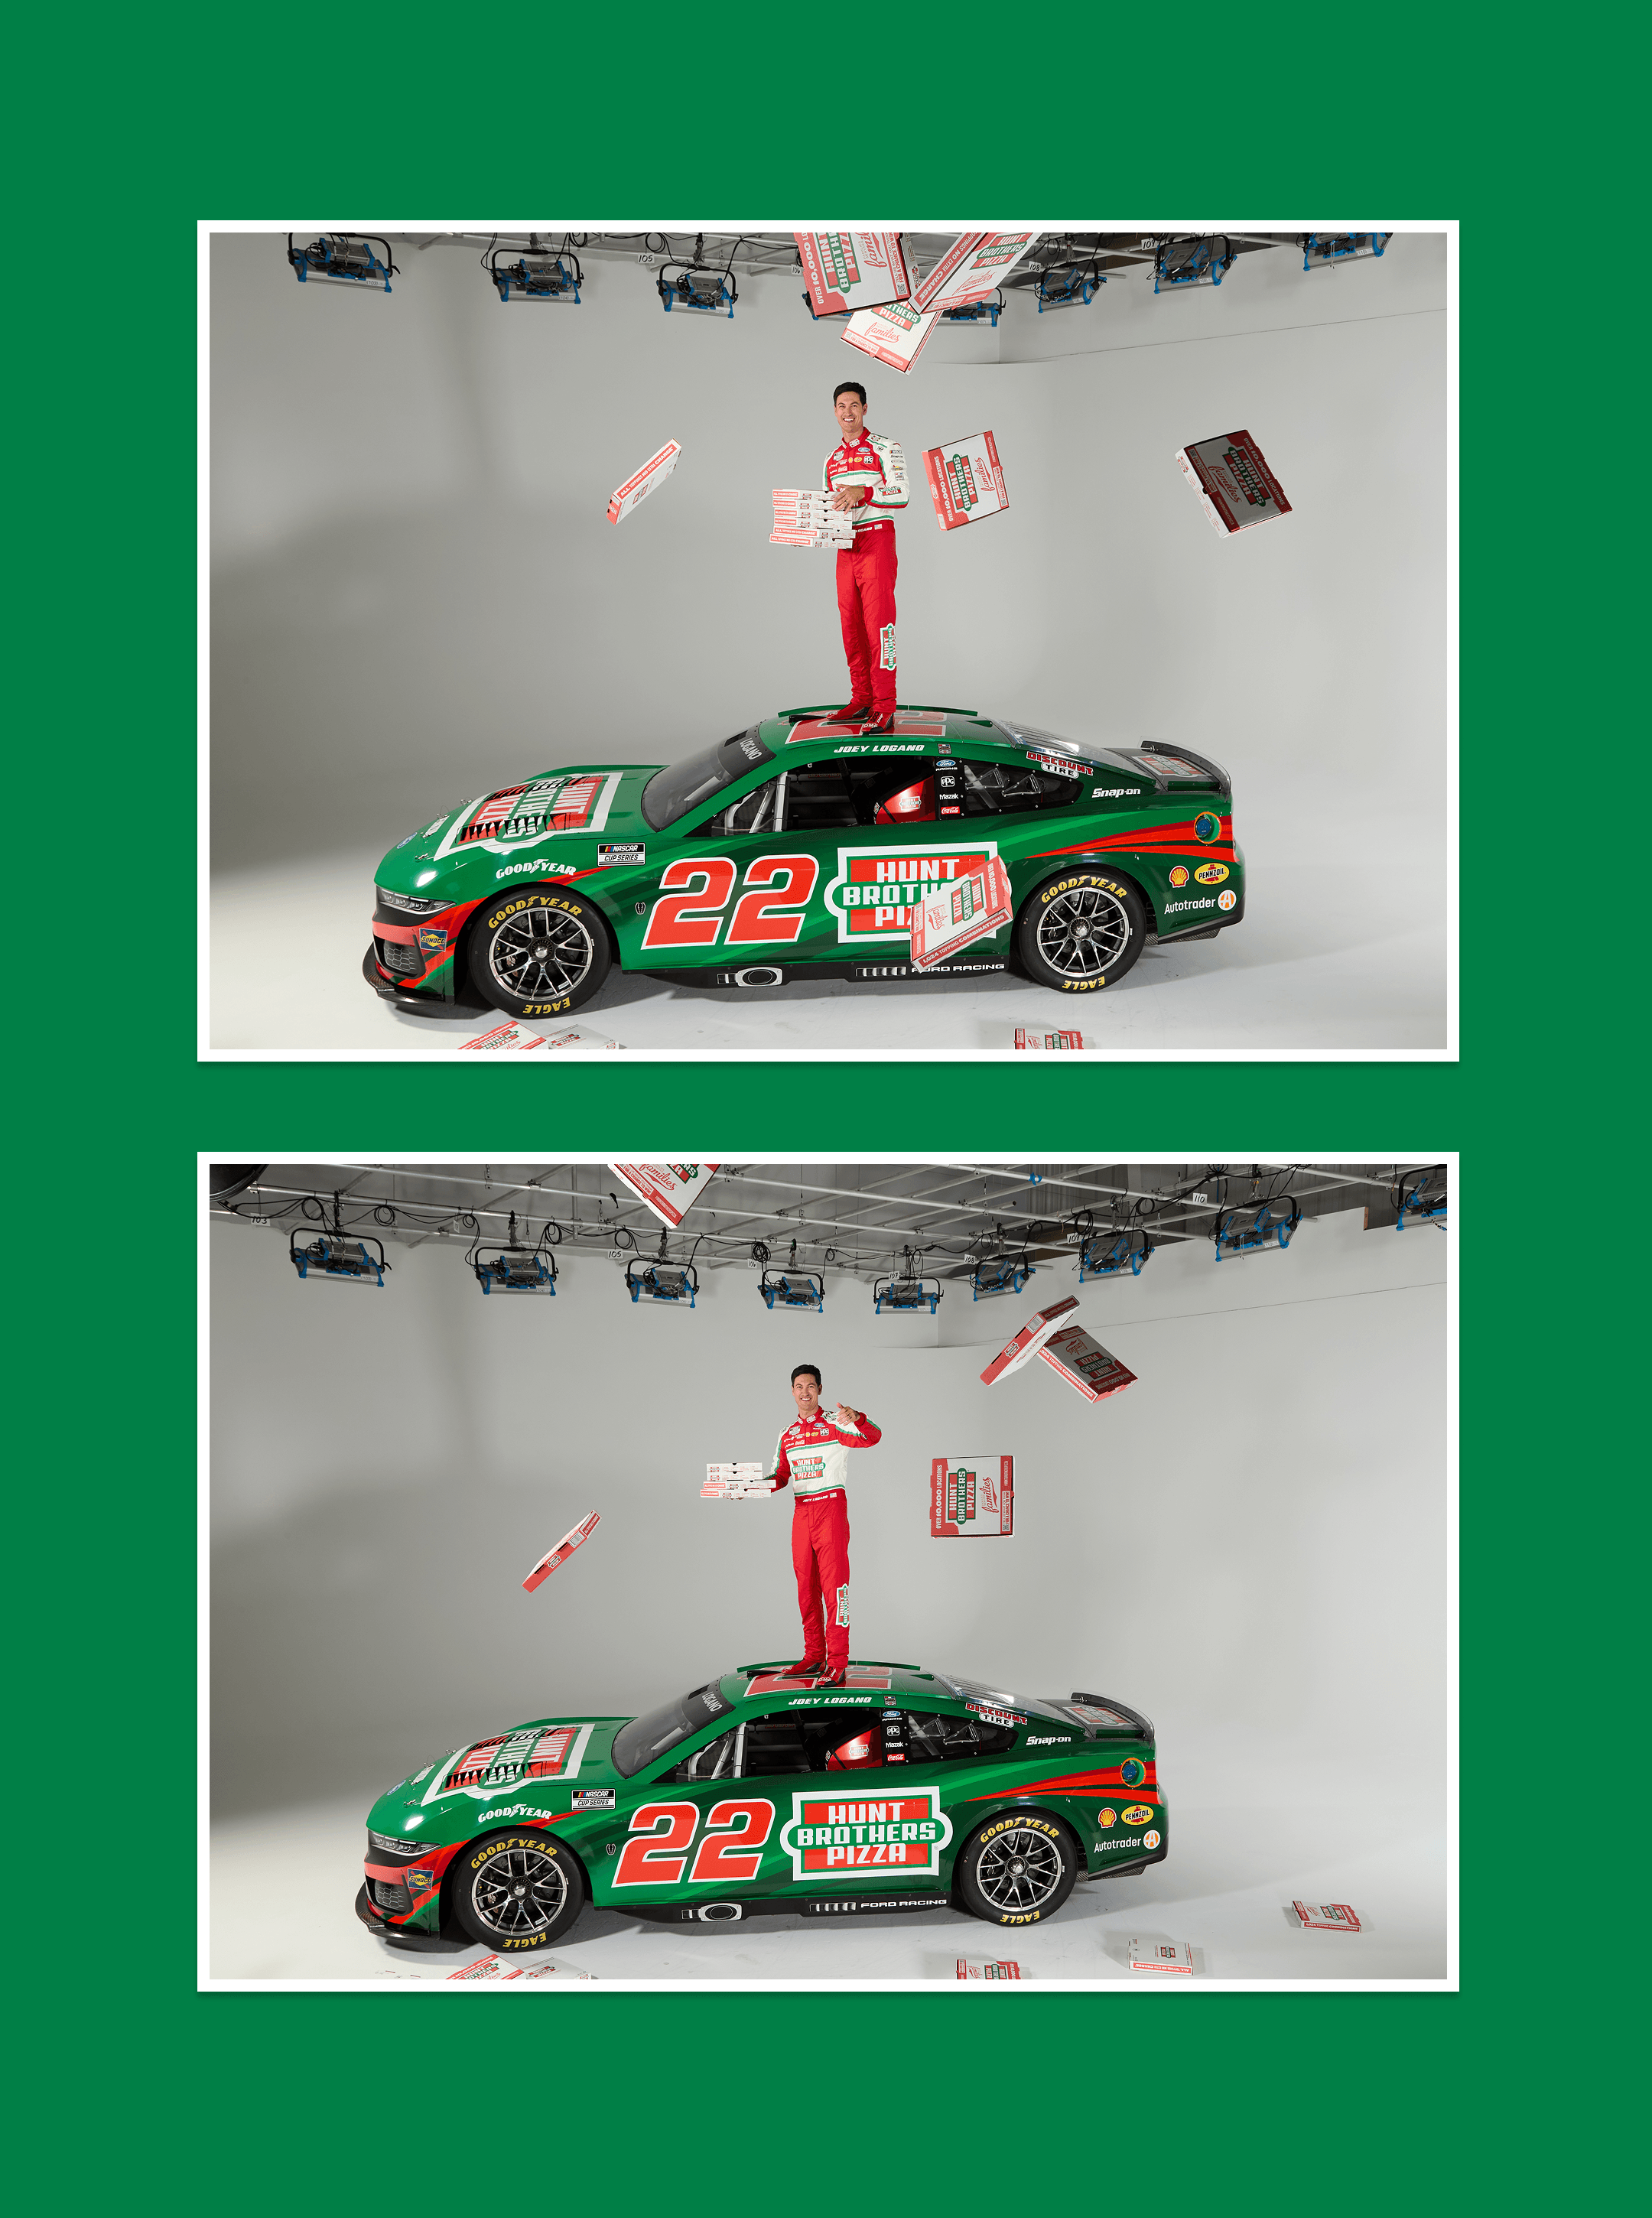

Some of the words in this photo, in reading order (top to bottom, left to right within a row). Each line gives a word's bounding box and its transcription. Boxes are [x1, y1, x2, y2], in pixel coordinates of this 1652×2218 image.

[960, 233, 977, 252] OPPINGS
[979, 242, 1025, 258] BROTHERS
[997, 233, 1026, 246] HUNT
[1143, 239, 1156, 249] 109
[639, 255, 653, 263] 105
[804, 242, 820, 285] 10,000
[830, 233, 850, 288] BROTH
[942, 260, 954, 272] EXTRA
[952, 250, 961, 260] NO
[980, 255, 1009, 267] PIZZA
[1029, 263, 1040, 272] 108
[815, 287, 824, 304] OVER
[920, 271, 944, 301] CHARGE
[879, 307, 906, 327] PIZZA
[886, 303, 919, 323] OTHERS
[864, 321, 901, 343] families
[620, 484, 631, 496] ALL
[654, 447, 673, 465] CHARGE
[934, 456, 944, 481] LOCATIONS
[964, 464, 975, 495] PIZZA
[974, 457, 995, 491] families
[1229, 463, 1252, 495] PIZZA
[1230, 450, 1264, 504] BROTHERS
[1243, 459, 1265, 489] HUNT
[1244, 437, 1253, 450] OVER
[1251, 449, 1270, 479] 10,000
[1268, 479, 1286, 506] LOCATIONS
[949, 472, 961, 499] HUNT
[954, 457, 971, 508] BROTHERS
[1208, 466, 1242, 502] families
[940, 481, 951, 509] 10,000
[740, 737, 763, 760] LOGANO
[873, 744, 925, 753] LOGANO
[1026, 751, 1094, 776] DISCOUNT
[1045, 764, 1075, 776] TIRE
[941, 777, 954, 786] PPG
[550, 782, 596, 815] HUNT
[1091, 788, 1141, 798] Snap-on
[496, 858, 577, 879] GOODYEAR
[876, 858, 960, 883] HUNT
[1198, 867, 1225, 880] PENNZOIL
[843, 882, 954, 906] BROTH
[972, 883, 982, 902] HUNT
[1041, 875, 1127, 903] GOODYEAR
[640, 854, 820, 950] 22
[952, 894, 962, 918] PIZZA
[962, 881, 972, 920] BROTHERS
[1163, 897, 1216, 915] Autotrader
[488, 896, 583, 929] GOODYEAR
[922, 952, 939, 964] 1,024
[939, 942, 959, 955] TOPPING
[959, 915, 1005, 943] COMBINATIONS
[1062, 976, 1106, 990] EAGLE
[522, 997, 571, 1014] EAGLE
[630, 1173, 642, 1185] CHANCE
[639, 1164, 678, 1191] families
[1195, 1195, 1205, 1203] 110
[252, 1215, 267, 1224] 103
[1068, 1234, 1080, 1243] 109
[1079, 1354, 1098, 1364] PIZZA
[1081, 1358, 1110, 1374] BROTHERS
[1049, 1357, 1063, 1371] TOPPING
[1062, 1368, 1094, 1398] COMBINATIONS
[1094, 1367, 1112, 1377] HUNT
[1108, 1375, 1124, 1385] 10,000
[793, 1464, 824, 1474] BROTHERS
[949, 1483, 958, 1511] HUNT
[958, 1471, 966, 1521] BROTHERS
[966, 1481, 974, 1511] PIZZA
[979, 1477, 999, 1513] families
[701, 1690, 723, 1712] LOGANO
[965, 1703, 1028, 1725] DISCOUNT
[982, 1714, 1010, 1725] TIRE
[888, 1727, 899, 1735] PPG
[1026, 1736, 1072, 1745] Snap-on
[528, 1733, 569, 1763] HUNT
[478, 1803, 552, 1823] GOODYEAR
[828, 1802, 905, 1825] HUNT
[1125, 1809, 1150, 1821] PENNZOIL
[797, 1822, 936, 1846] BROTHERS
[980, 1816, 1060, 1843] GOODYEAR
[471, 1838, 558, 1868] GOODYEAR
[611, 1798, 776, 1888] 22
[827, 1843, 906, 1865] PIZZA
[1094, 1837, 1142, 1853] Autotrader
[1000, 1910, 1040, 1924] EAGLE
[502, 1932, 547, 1948] EAGLE
